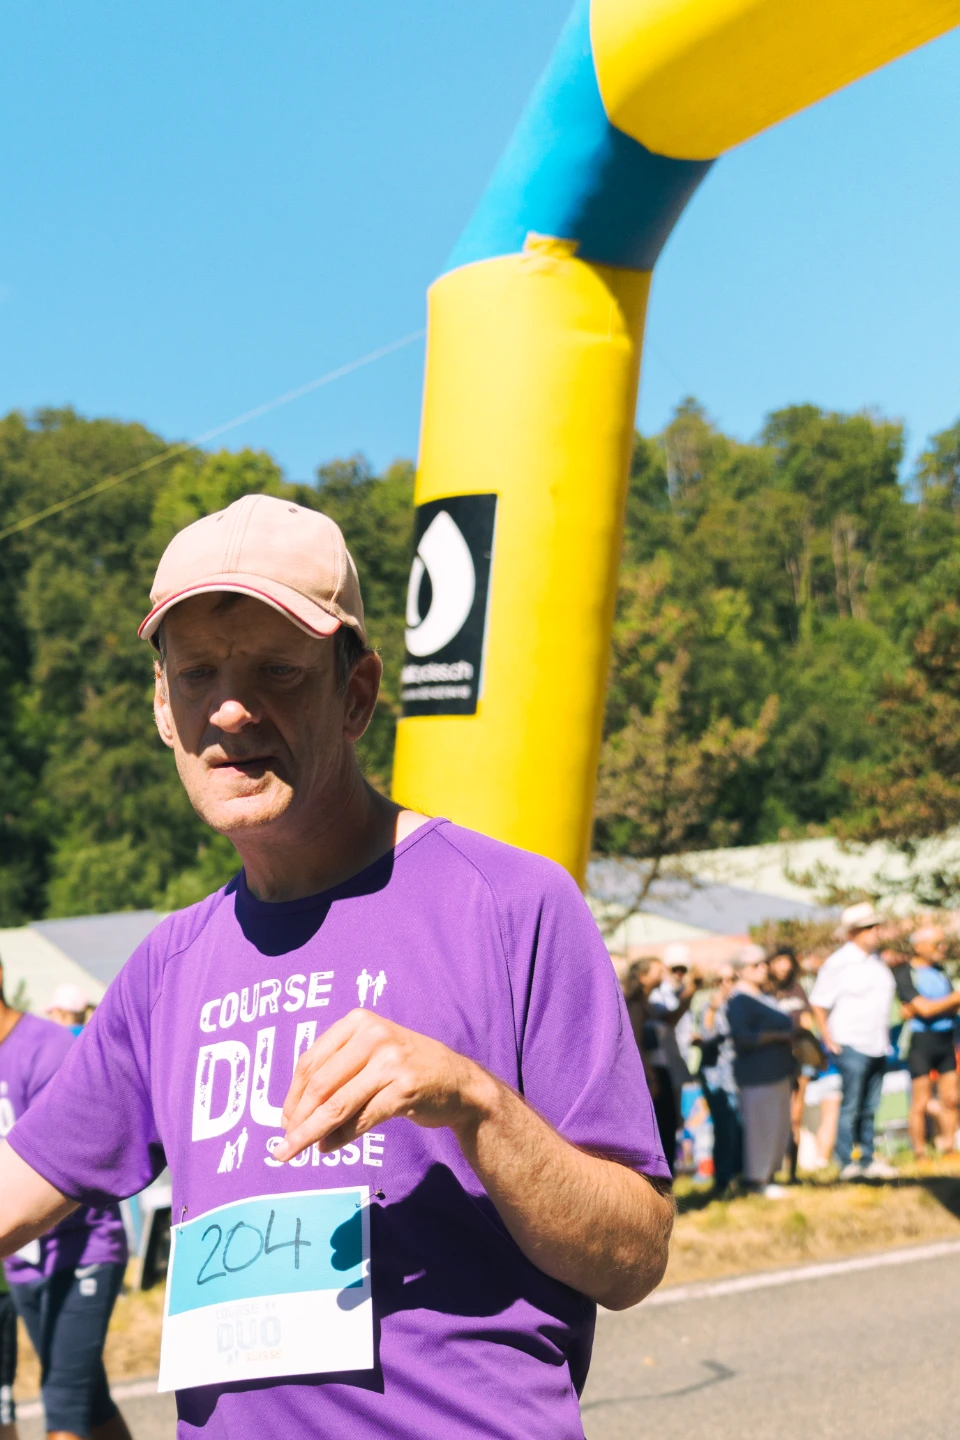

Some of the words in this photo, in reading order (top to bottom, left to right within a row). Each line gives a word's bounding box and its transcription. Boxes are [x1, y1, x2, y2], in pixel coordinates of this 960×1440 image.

[199, 970, 335, 1033] COURSE
[191, 1020, 318, 1142] DU
[196, 1209, 312, 1286] 204
[216, 1316, 282, 1354] DUO
